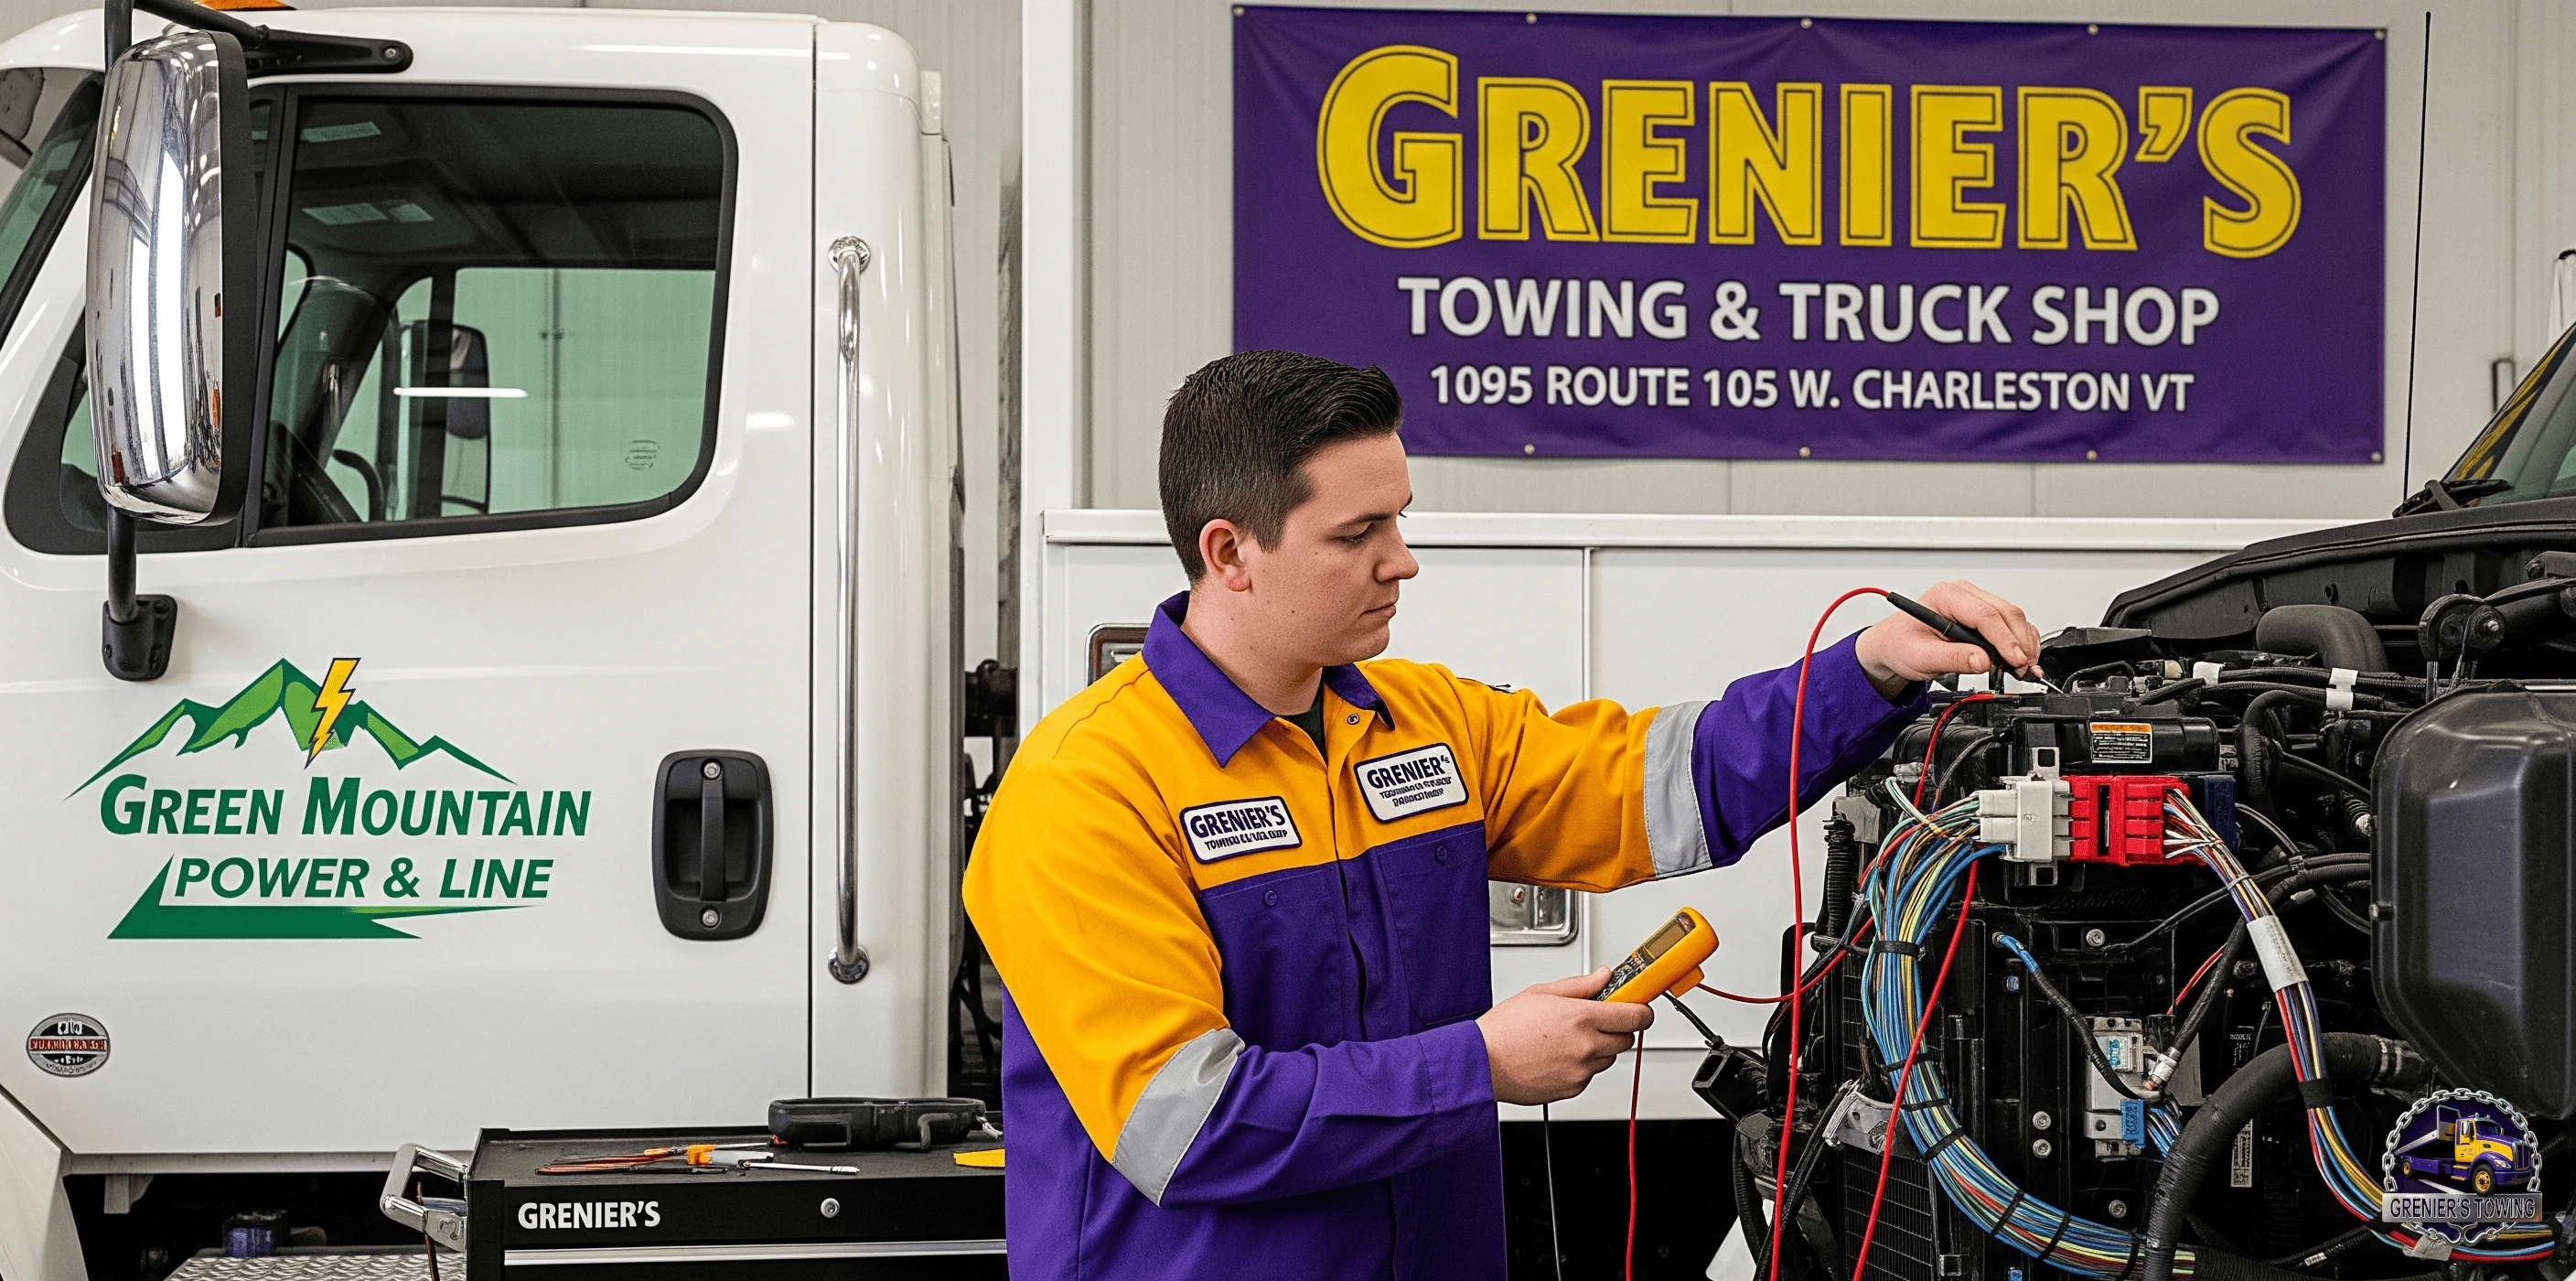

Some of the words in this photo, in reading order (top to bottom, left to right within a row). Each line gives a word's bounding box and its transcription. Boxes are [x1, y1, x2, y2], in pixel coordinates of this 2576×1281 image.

[1316, 44, 2302, 258] GRENIER'S
[1398, 276, 1689, 339] TOWING
[1709, 282, 1761, 341] &
[1779, 283, 2012, 345] TRUCK
[2031, 285, 2220, 347] SHOP
[1430, 364, 1533, 406] 1095
[1547, 366, 1690, 408] ROUTE
[1703, 369, 1779, 408] 105
[1790, 370, 1840, 410] W.
[1852, 369, 2130, 412] CHARLESTON
[2141, 372, 2194, 413] VT
[101, 774, 284, 836] GREEN
[302, 776, 592, 836] MOUNTAIN
[1190, 805, 1286, 838] GRENIER'S
[175, 857, 370, 898] POWER
[383, 856, 421, 899] &
[440, 858, 554, 899] LINE
[518, 1200, 660, 1229] GRENIER'S
